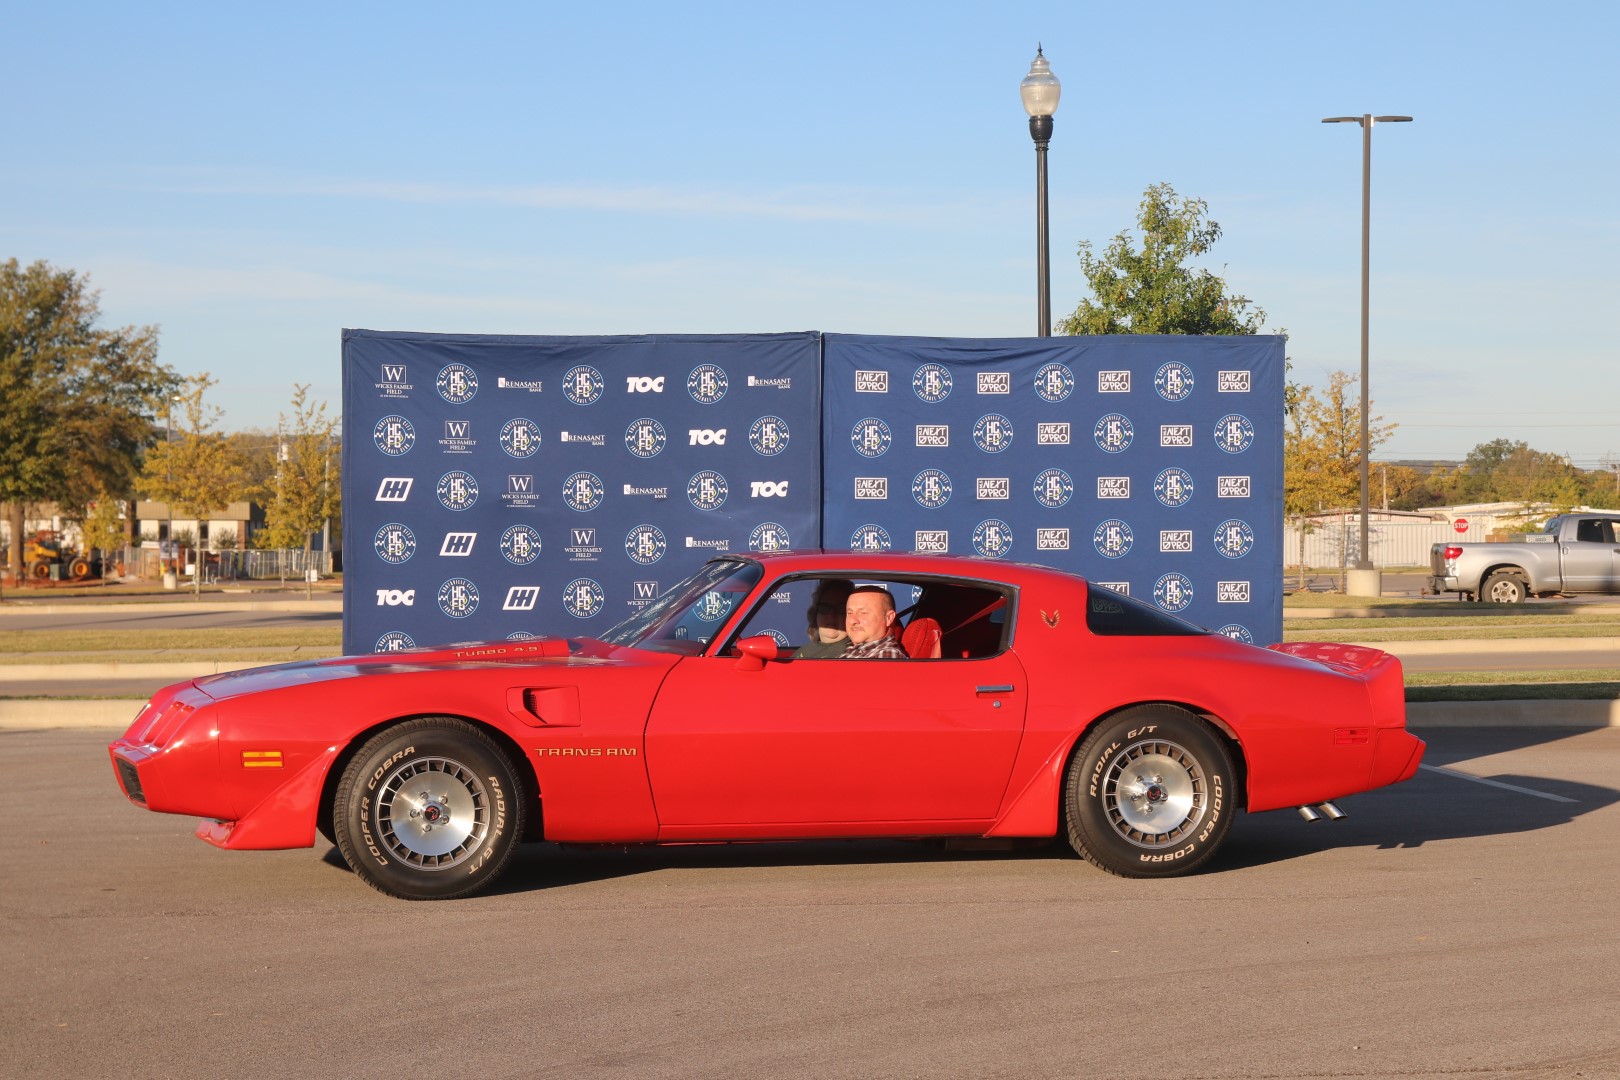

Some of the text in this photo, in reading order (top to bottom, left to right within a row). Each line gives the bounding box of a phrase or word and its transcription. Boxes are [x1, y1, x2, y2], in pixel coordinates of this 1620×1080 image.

[384, 366, 404, 381] W
[451, 372, 463, 383] HC
[701, 372, 714, 383] HC
[862, 373, 885, 382] NEXT
[926, 371, 938, 382] HC
[1048, 371, 1060, 382] HC
[1105, 373, 1128, 382] NEXT
[1168, 370, 1180, 381] HC
[1225, 373, 1248, 382] NEXT
[577, 374, 589, 385] HC
[627, 376, 664, 393] TOC
[984, 375, 1007, 384] NEXT
[451, 384, 463, 395] FC
[577, 386, 589, 397] FC
[701, 384, 714, 395] FC
[868, 382, 885, 390] PRO
[926, 383, 938, 394] FC
[990, 384, 1007, 392] PRO
[1048, 383, 1060, 394] FC
[1111, 382, 1128, 390] PRO
[1168, 382, 1180, 393] FC
[1231, 382, 1248, 390] PRO
[388, 424, 401, 435] HC
[448, 422, 467, 437] W
[514, 426, 526, 438] HC
[639, 426, 652, 438] HC
[763, 424, 775, 435] HC
[865, 426, 877, 437] HC
[923, 428, 946, 436] NEXT
[986, 422, 999, 433] HC
[1044, 425, 1067, 434] NEXT
[1108, 422, 1120, 433] HC
[1167, 428, 1190, 436] NEXT
[1228, 422, 1240, 433] HC
[388, 436, 401, 447] FC
[689, 429, 726, 445] TOC
[763, 436, 775, 447] FC
[929, 436, 946, 445] PRO
[986, 434, 999, 445] FC
[1050, 434, 1067, 442] PRO
[1108, 434, 1120, 445] FC
[1173, 436, 1190, 445] PRO
[1228, 434, 1240, 445] FC
[514, 438, 526, 450] FC
[639, 438, 652, 450] FC
[865, 438, 877, 449] FC
[451, 479, 464, 490] HC
[511, 477, 530, 491] W
[577, 480, 589, 491] HC
[701, 479, 714, 490] HC
[861, 480, 884, 489] NEXT
[926, 477, 938, 488] HC
[983, 480, 1006, 489] NEXT
[1047, 477, 1059, 488] HC
[1104, 479, 1127, 488] NEXT
[1167, 476, 1180, 487] HC
[1224, 479, 1247, 487] NEXT
[751, 481, 788, 497] TOC
[867, 489, 884, 497] PRO
[926, 489, 938, 500] FC
[989, 489, 1006, 497] PRO
[1047, 489, 1059, 500] FC
[1110, 488, 1127, 496] PRO
[1167, 488, 1180, 499] FC
[1230, 487, 1247, 496] PRO
[451, 491, 464, 502] FC
[577, 492, 589, 503] FC
[701, 491, 714, 502] FC
[389, 532, 401, 543] HC
[573, 530, 593, 545] W
[763, 531, 775, 542] HC
[922, 533, 945, 542] NEXT
[986, 527, 998, 538] HC
[1044, 531, 1066, 539] NEXT
[1107, 527, 1119, 538] HC
[1167, 533, 1189, 541] NEXT
[1227, 527, 1240, 538] HC
[514, 533, 527, 544] HC
[639, 533, 652, 544] HC
[864, 533, 877, 544] HC
[1049, 540, 1067, 548] PRO
[389, 544, 401, 555] FC
[928, 542, 945, 550] PRO
[986, 539, 998, 550] FC
[1107, 539, 1119, 550] FC
[1172, 542, 1190, 550] PRO
[1227, 539, 1240, 550] FC
[514, 545, 527, 556] FC
[639, 545, 652, 556] FC
[452, 586, 465, 598] HC
[577, 586, 590, 598] HC
[636, 583, 656, 598] W
[1167, 581, 1179, 592] HC
[1224, 584, 1247, 592] NEXT
[377, 589, 414, 606] TOC
[706, 592, 719, 604] HC
[1167, 593, 1179, 604] FC
[1230, 592, 1247, 600] PRO
[452, 598, 465, 610] FC
[577, 598, 590, 610] FC
[706, 605, 719, 615] FC
[452, 648, 507, 657] TURBO
[534, 748, 637, 756] TRANS AM
[1090, 725, 1157, 798] RADIAL G/T
[360, 746, 416, 866] COOPER COBRA
[1140, 775, 1223, 862] COOPER COBRA
[468, 776, 506, 875] RADIAL G/T
